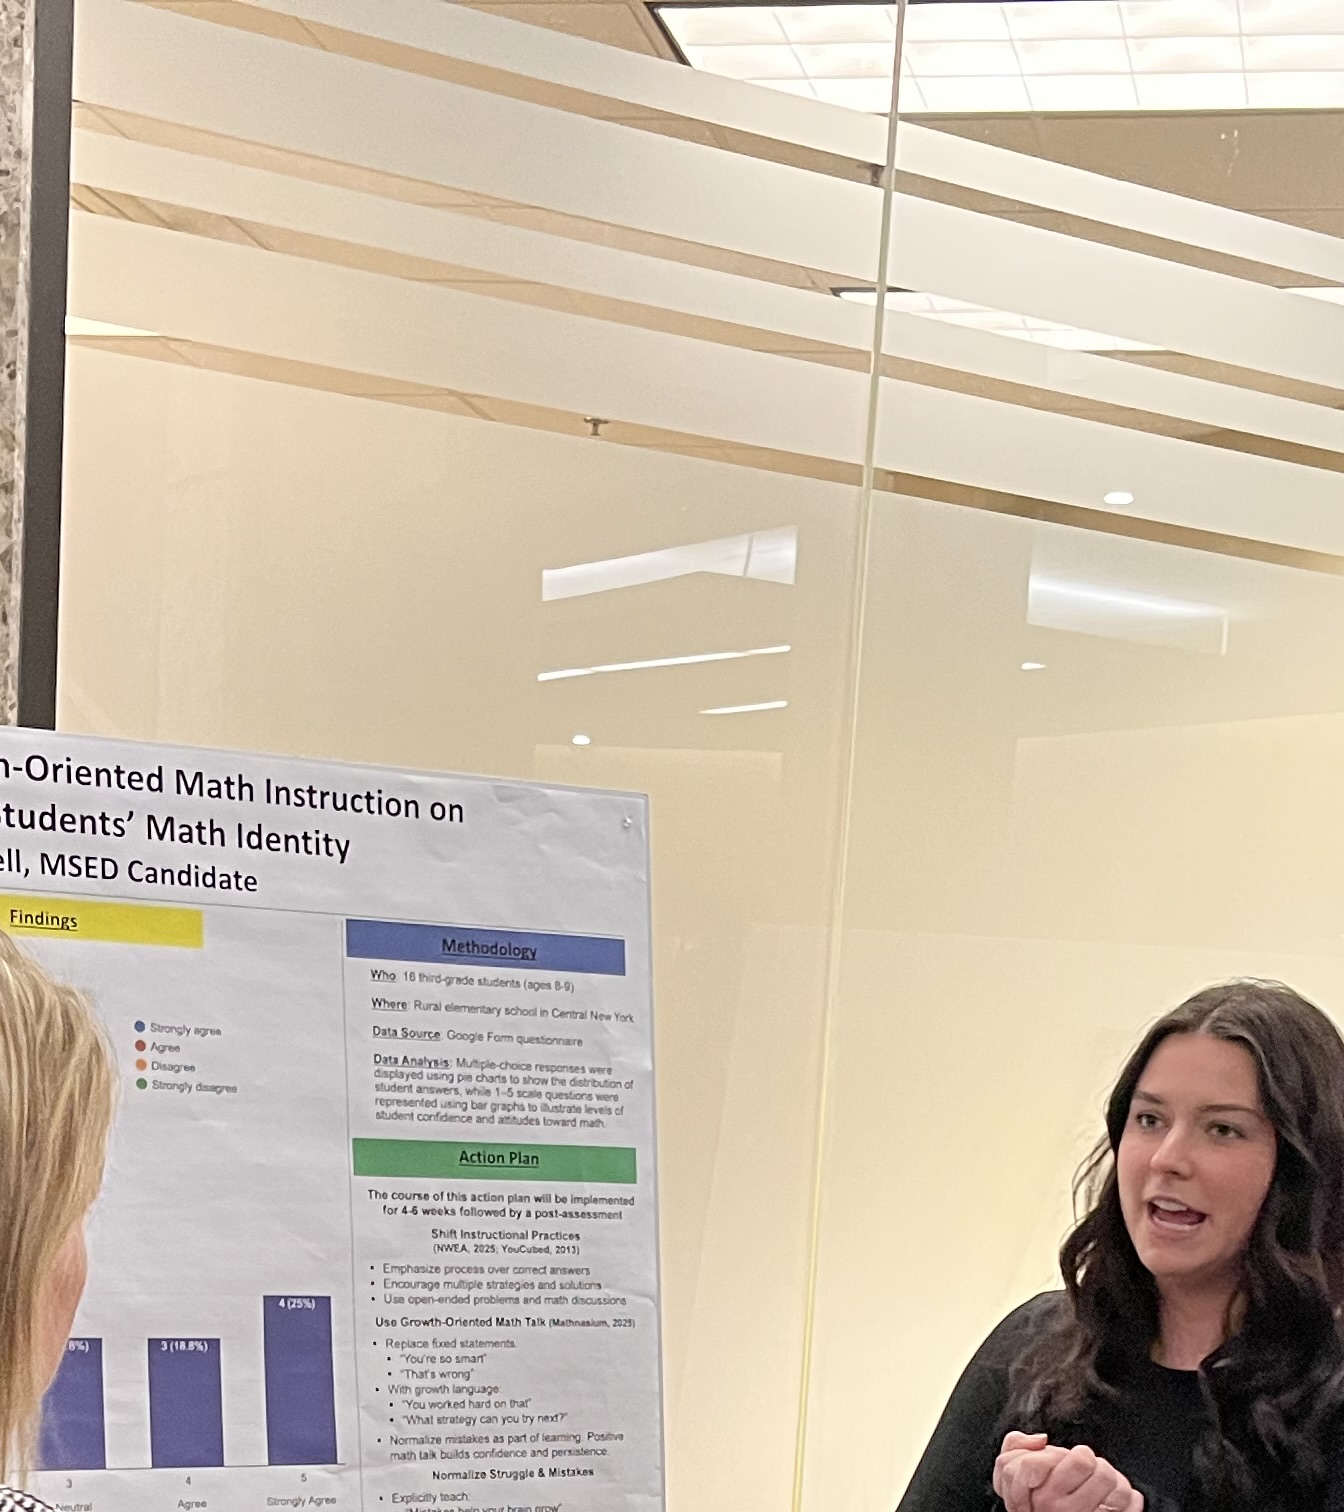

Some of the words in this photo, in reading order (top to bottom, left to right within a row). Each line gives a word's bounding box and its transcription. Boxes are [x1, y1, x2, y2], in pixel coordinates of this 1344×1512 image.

[175, 768, 254, 803] Math
[265, 777, 420, 820] Instruction
[430, 800, 464, 824] on
[146, 813, 226, 848] Math
[237, 821, 350, 865] Identity
[40, 851, 119, 881] MSED
[127, 859, 258, 893] Candidate
[9, 908, 78, 932] Findings
[442, 939, 538, 961] Methodology
[413, 998, 442, 1013] Rural
[444, 1001, 502, 1019] elementary
[504, 1005, 538, 1018] school
[539, 1007, 549, 1019] in
[551, 1006, 588, 1021] Central
[589, 1009, 612, 1023] New
[613, 1011, 635, 1025] York
[150, 1021, 192, 1038] Strongly
[193, 1026, 222, 1038] agree
[149, 1040, 181, 1055] Agree
[150, 1059, 196, 1075] Disagree
[151, 1078, 193, 1095] Strongly
[195, 1081, 238, 1097] disagree
[459, 1150, 505, 1165] Action
[509, 1151, 539, 1166] Plan
[367, 1187, 389, 1202] The
[390, 1191, 430, 1203] course
[432, 1190, 445, 1203] of
[446, 1190, 468, 1203] this
[470, 1191, 505, 1204] action
[507, 1192, 531, 1206] plan
[533, 1192, 552, 1204] will
[554, 1193, 568, 1206] be
[570, 1193, 635, 1207] implemented
[431, 1227, 458, 1240] Shift
[460, 1227, 529, 1241] Instructional
[531, 1229, 581, 1243] Practices
[278, 1297, 286, 1309] 4
[286, 1296, 316, 1312] (25%)
[375, 1316, 398, 1329] Use
[400, 1315, 493, 1329] Growth-Oriented
[495, 1315, 522, 1328] Math
[524, 1316, 546, 1328] Talk
[160, 1339, 168, 1352] 3
[169, 1339, 209, 1354] (18.8%)
[185, 1475, 192, 1486] 4
[300, 1471, 308, 1483] 5
[432, 1468, 487, 1481] Normalize
[489, 1467, 535, 1482] Struggle
[537, 1466, 546, 1479] &
[548, 1466, 595, 1479] Mistakes
[65, 1477, 73, 1490] 3
[177, 1498, 208, 1512] Agree
[266, 1495, 307, 1509] Strongly
[307, 1494, 337, 1508] Agree
